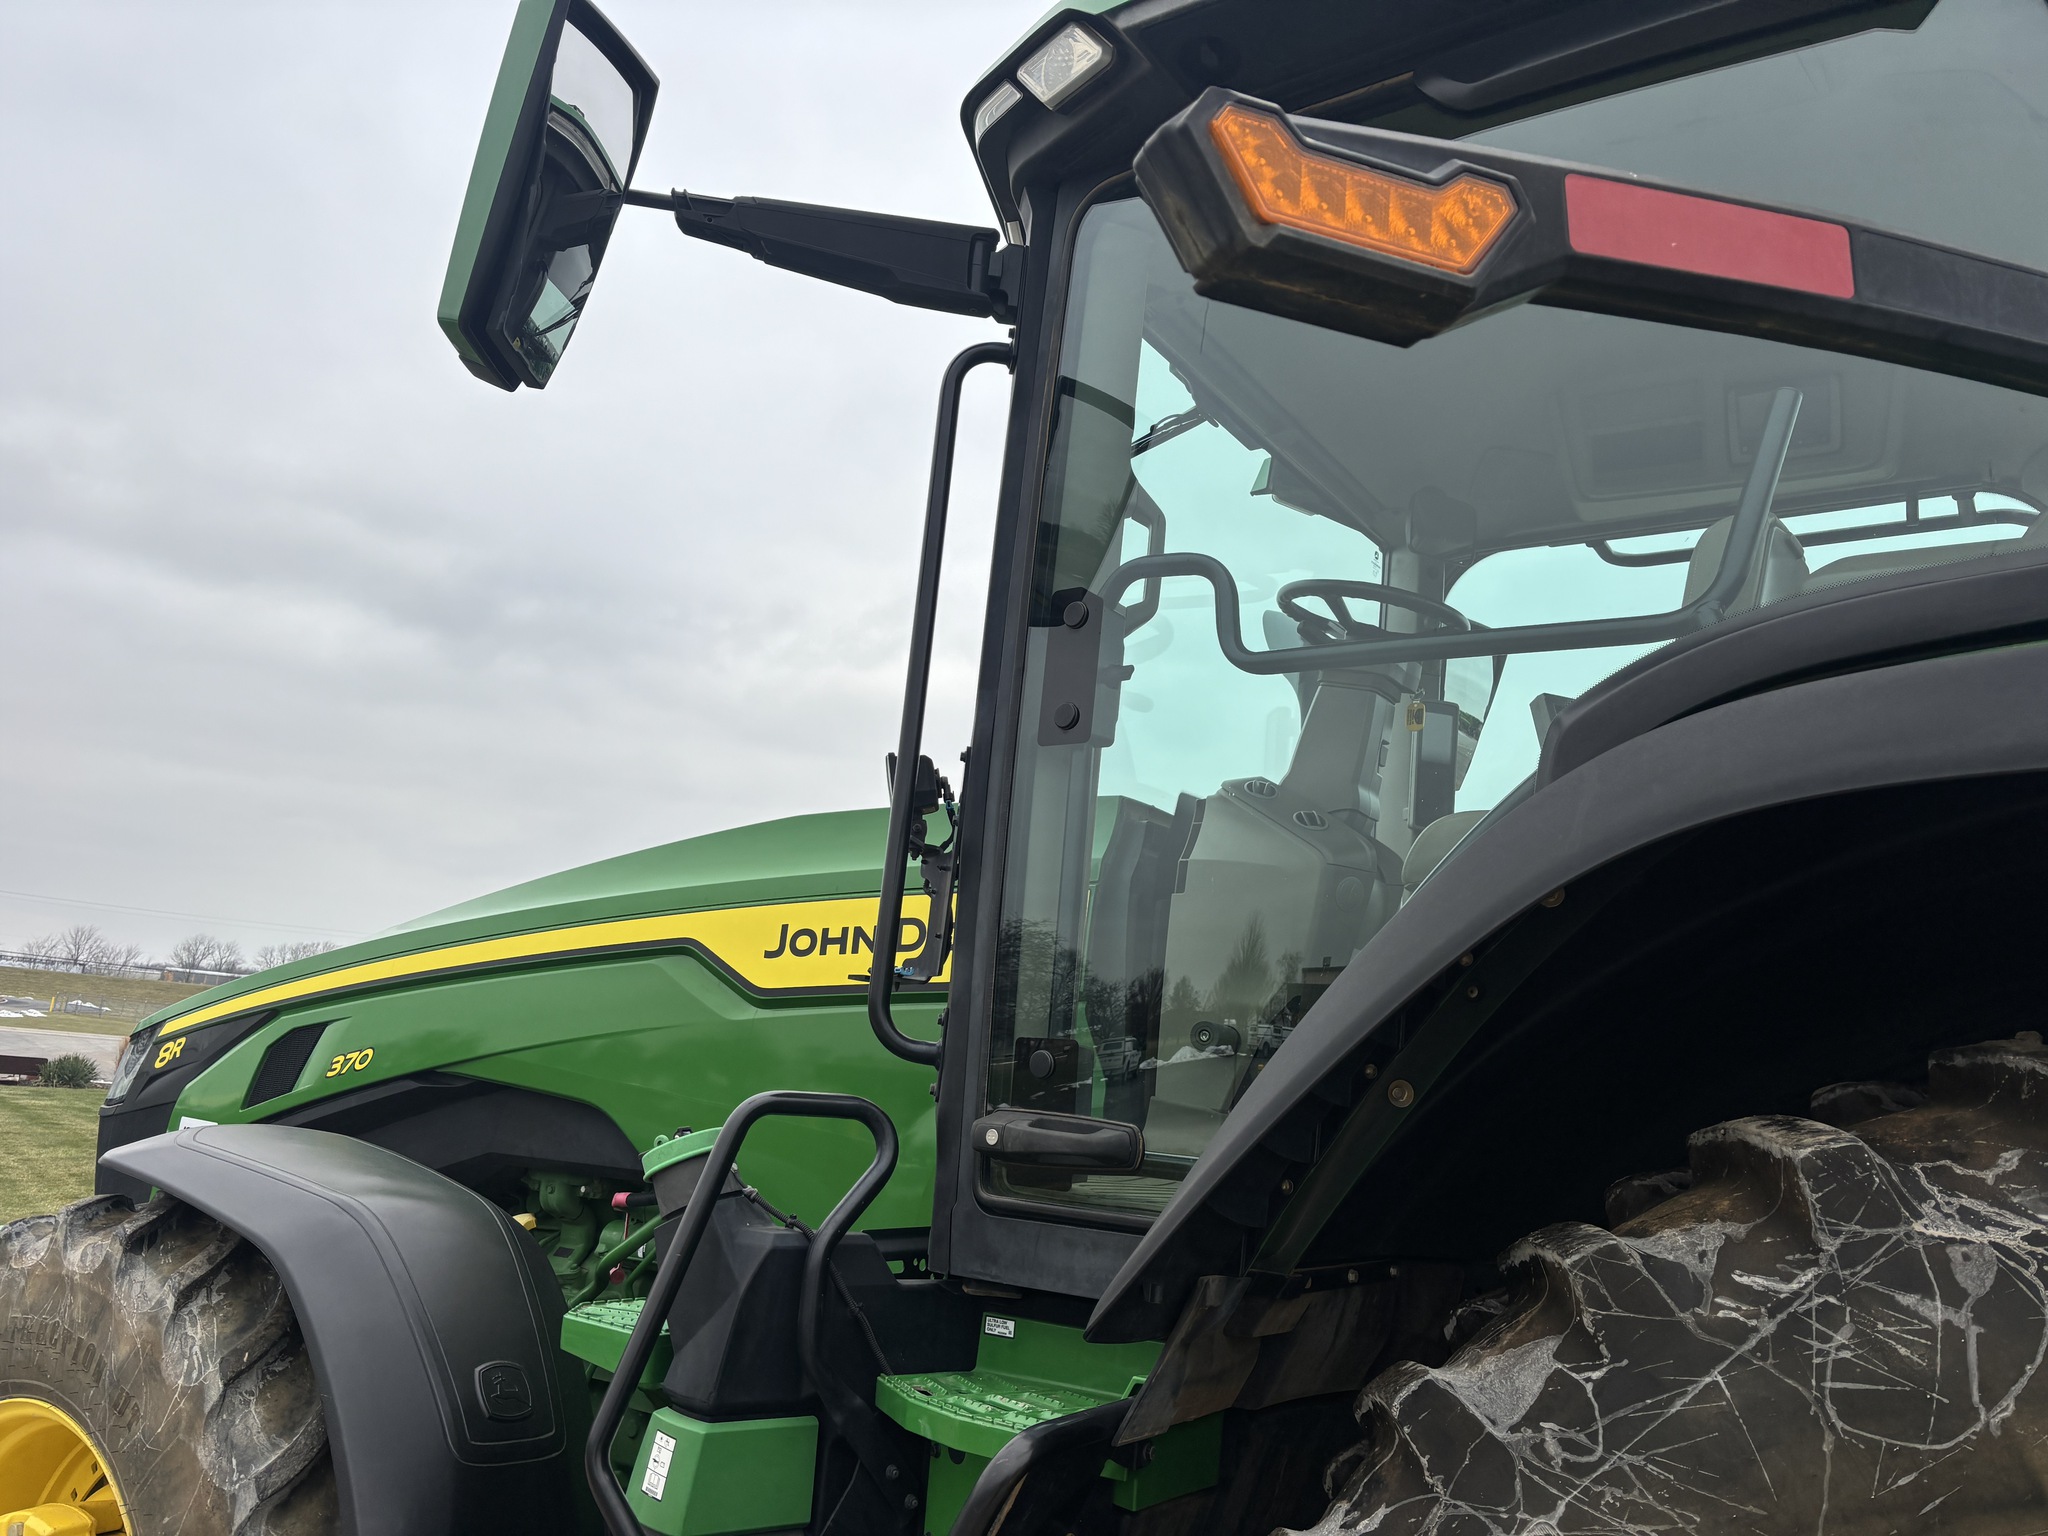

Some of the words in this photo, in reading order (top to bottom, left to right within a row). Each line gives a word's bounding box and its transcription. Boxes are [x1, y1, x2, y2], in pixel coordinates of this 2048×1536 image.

[764, 923, 878, 958] JOHN
[154, 1036, 187, 1069] 8R
[325, 1047, 375, 1079] 370
